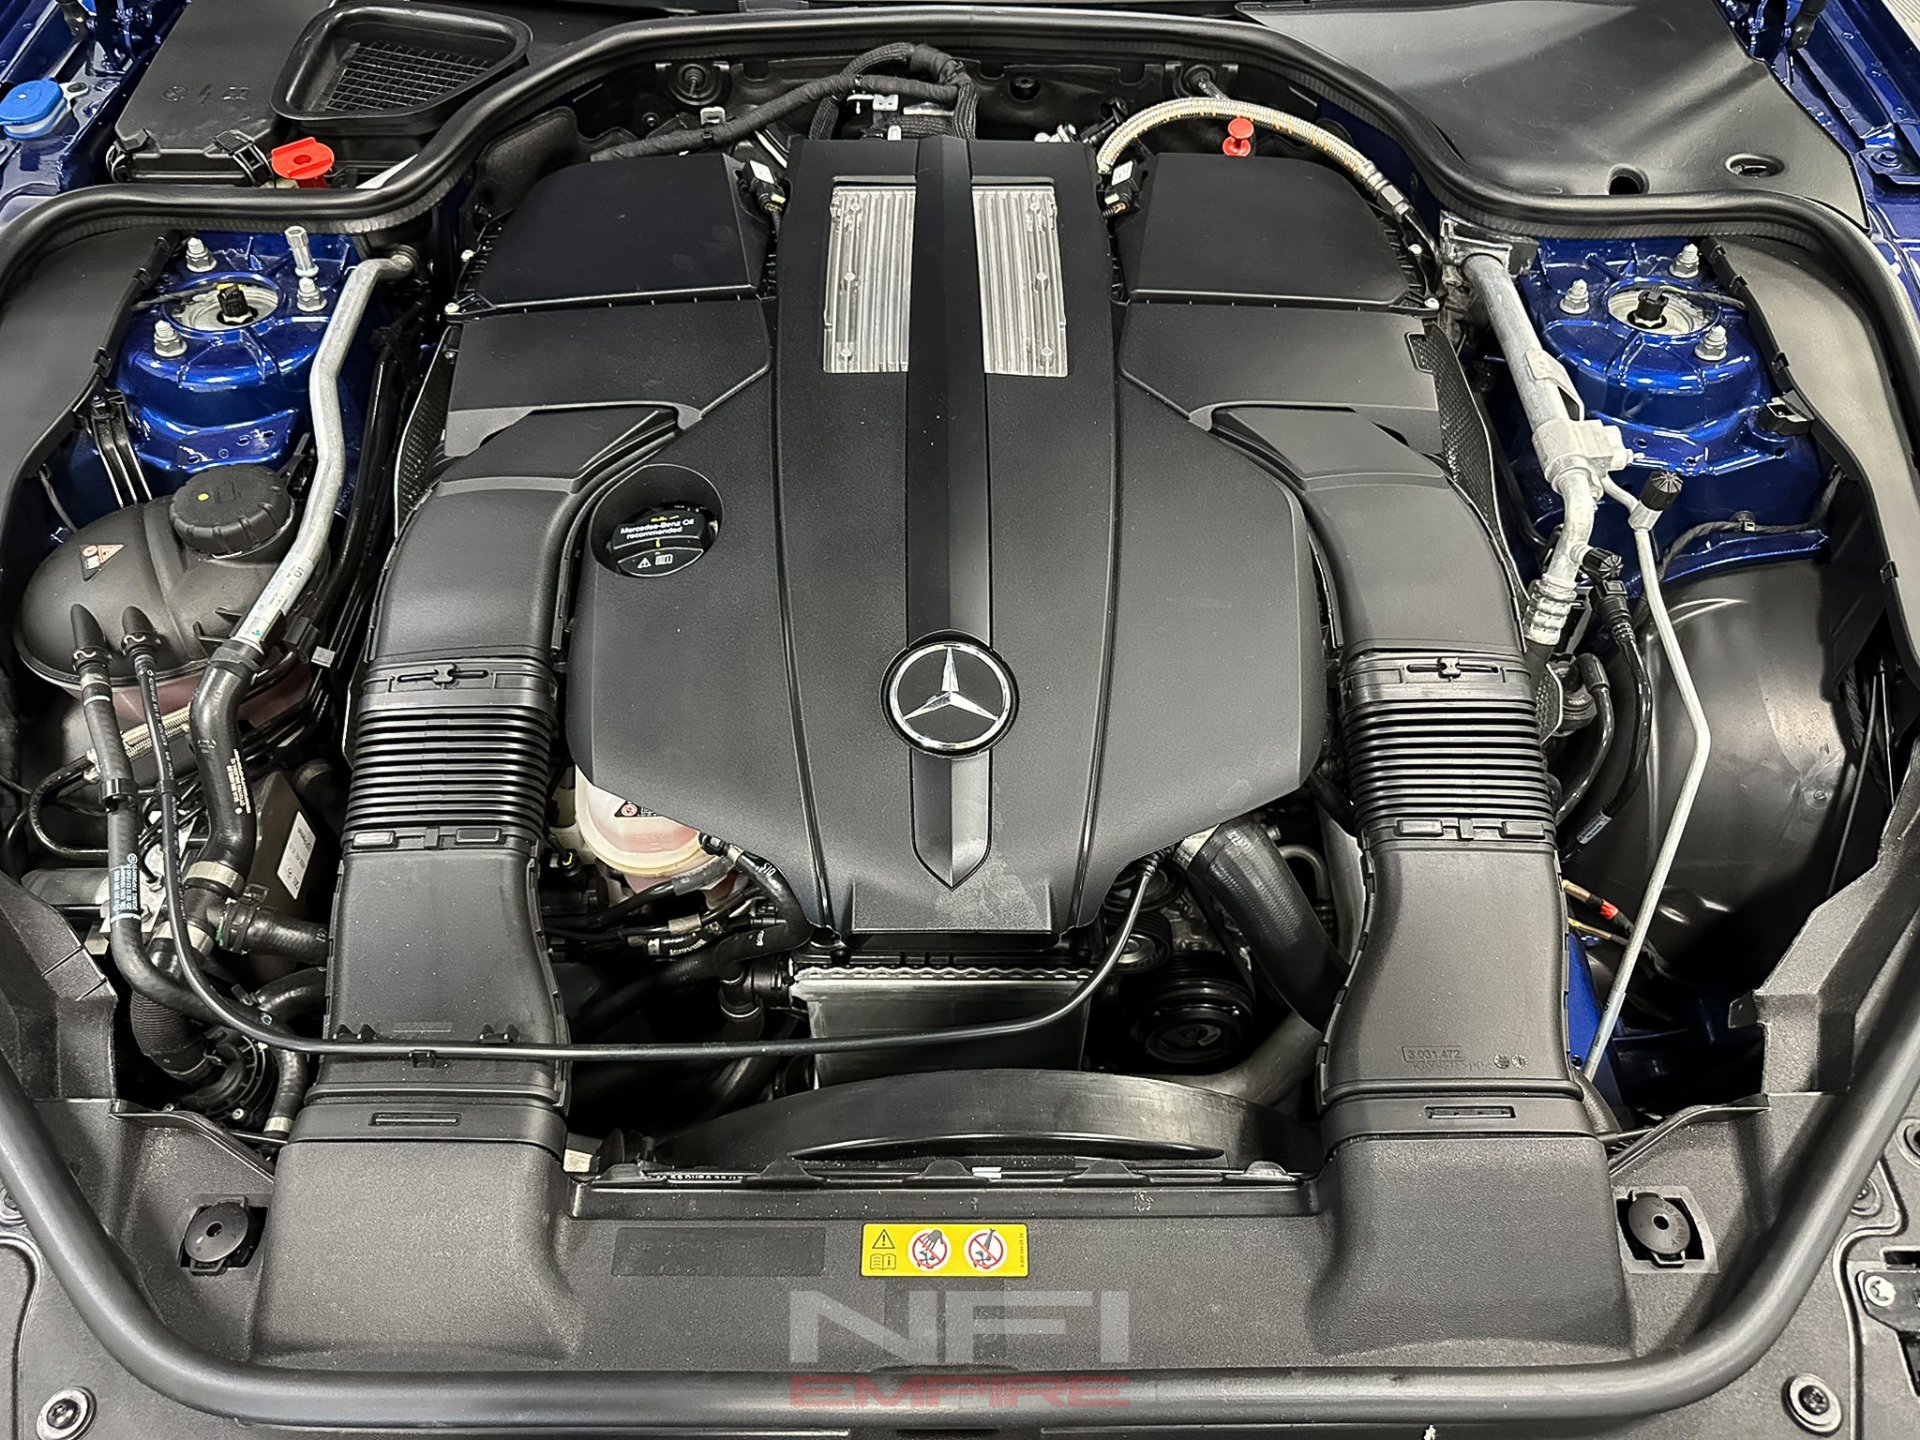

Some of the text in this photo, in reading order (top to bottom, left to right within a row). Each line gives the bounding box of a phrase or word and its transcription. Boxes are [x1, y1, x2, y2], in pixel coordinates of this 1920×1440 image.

[620, 521, 681, 534] Mercedes-Benz
[681, 518, 695, 527] Oil
[626, 526, 683, 540] recommended
